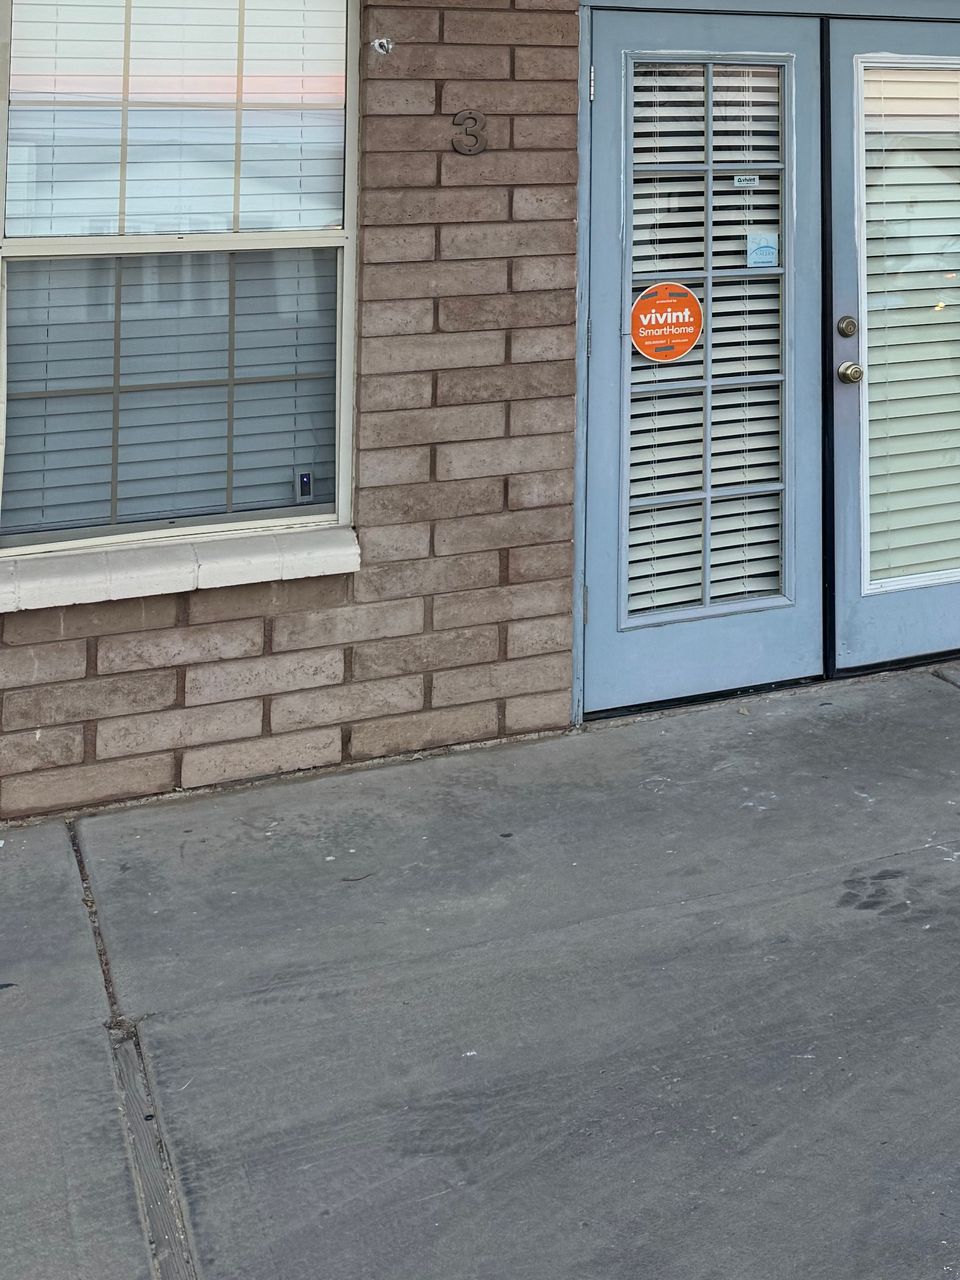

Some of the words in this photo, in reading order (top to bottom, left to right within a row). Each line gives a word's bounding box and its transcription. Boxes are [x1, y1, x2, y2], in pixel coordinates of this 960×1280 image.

[452, 109, 488, 156] 3
[640, 308, 694, 325] vivint.
[639, 325, 694, 336] SmartHome
